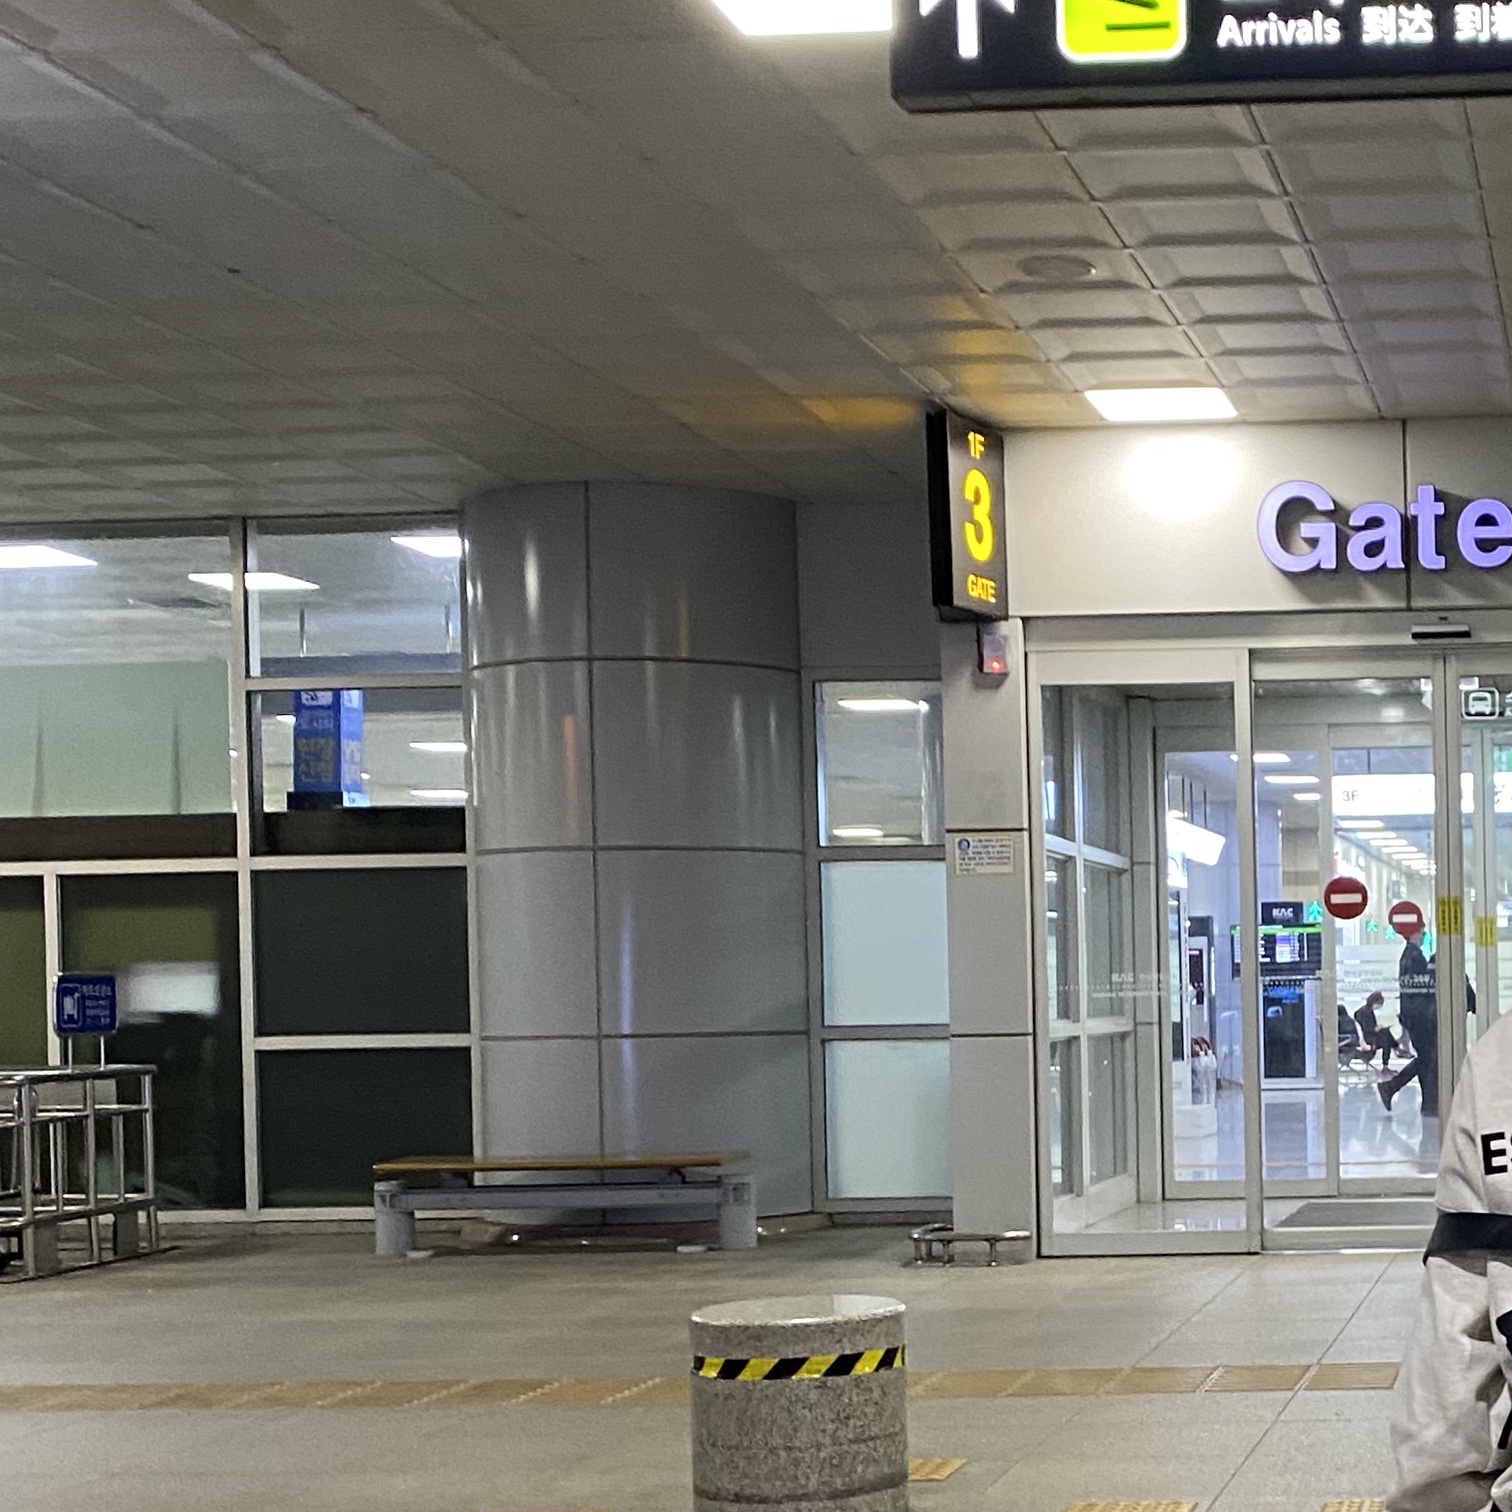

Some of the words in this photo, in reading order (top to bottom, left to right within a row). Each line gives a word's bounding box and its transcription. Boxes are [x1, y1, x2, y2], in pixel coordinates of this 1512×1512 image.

[1216, 9, 1342, 47] Arrivals
[1360, 4, 1435, 44] 到达
[967, 431, 985, 459] 1F
[964, 468, 993, 561] 3
[967, 575, 997, 603] GATE
